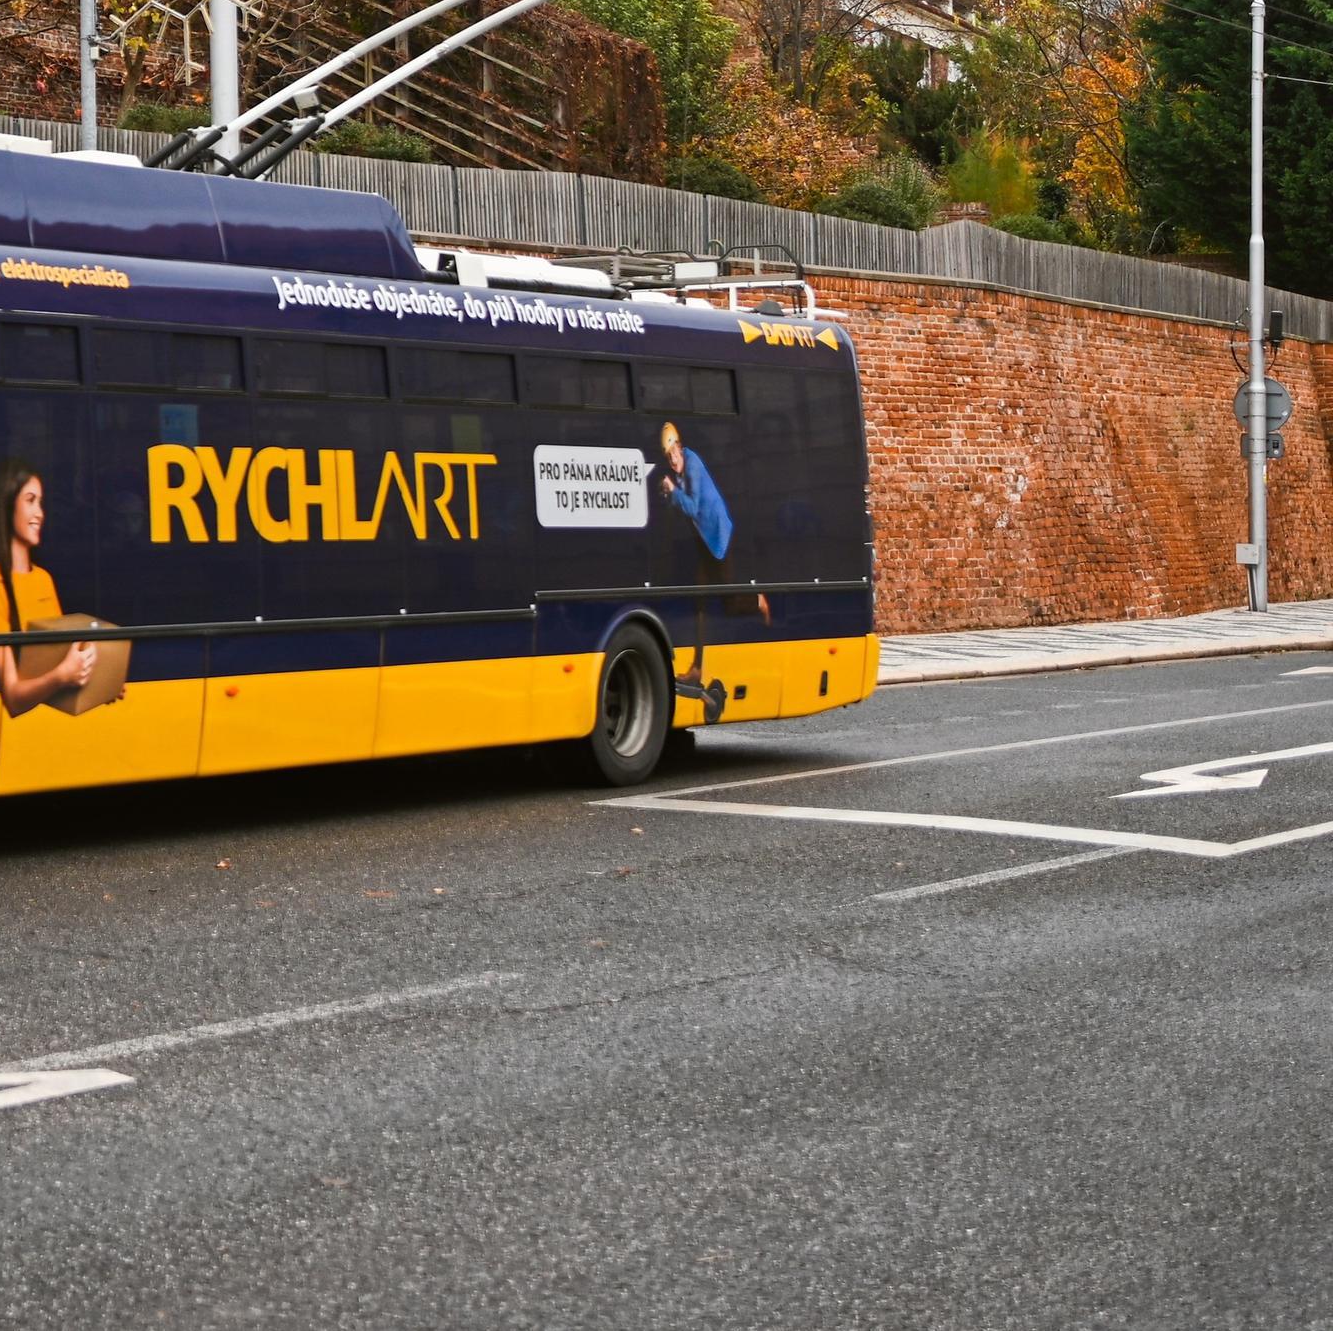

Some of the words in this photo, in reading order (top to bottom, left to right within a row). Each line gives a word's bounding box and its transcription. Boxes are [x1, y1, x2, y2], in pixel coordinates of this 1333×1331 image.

[0, 256, 131, 289] elektrospecialista
[272, 276, 373, 311] Jednoduše
[372, 284, 464, 323] objednáte,
[463, 291, 486, 319] do
[486, 294, 514, 327] půl
[564, 308, 578, 328] u
[577, 305, 607, 330] nás
[605, 307, 645, 334] máte
[539, 462, 561, 480] PRO
[563, 458, 592, 481] PÁNA
[594, 459, 642, 486] KRÁLOVÉ,
[146, 443, 498, 543] RYCHLART
[555, 491, 569, 509] TO
[570, 491, 580, 513] JE
[582, 492, 630, 509] RYCHLOST
